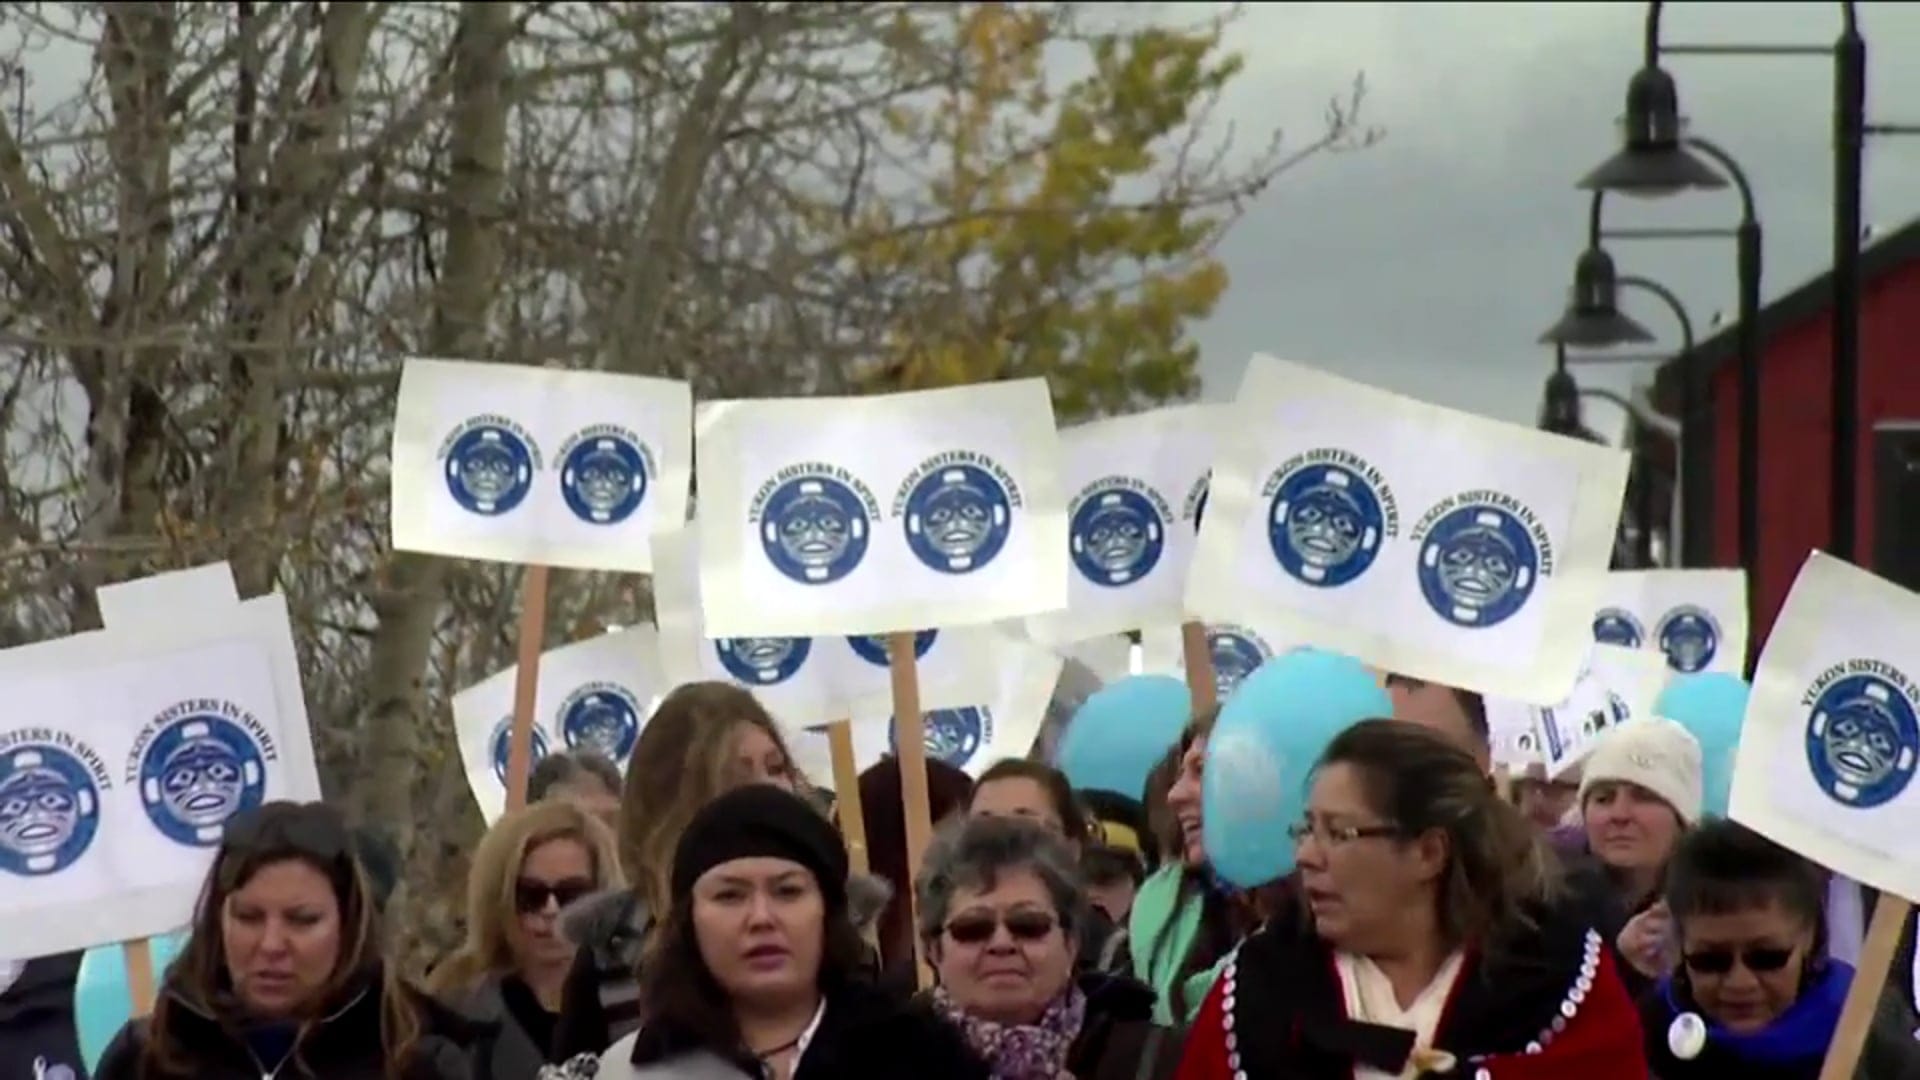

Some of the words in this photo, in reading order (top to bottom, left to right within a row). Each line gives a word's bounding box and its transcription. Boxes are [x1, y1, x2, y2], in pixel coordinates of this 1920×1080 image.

[748, 471, 778, 523] YUKON
[779, 463, 833, 482] SISTERS
[835, 465, 852, 482] IN
[851, 474, 882, 523] SPIRIT
[892, 467, 921, 517] YUKON
[919, 450, 976, 474] SISTERS
[977, 452, 994, 468] IN
[994, 461, 1023, 510] SPIRIT
[1262, 454, 1305, 497] YUKON
[1306, 448, 1367, 472] SISTERS
[1367, 465, 1384, 486] IN
[1379, 482, 1399, 538] SPIRIT
[1410, 496, 1456, 541] YUKON
[1457, 489, 1521, 511] SISTERS
[1520, 504, 1537, 525] IN
[1532, 521, 1553, 578] SPIRIT
[1801, 662, 1847, 708] YUKON
[1848, 658, 1907, 687] SISTERS
[0, 727, 53, 745] STERS
[55, 730, 74, 747] IN
[74, 741, 113, 791] SPIRIT
[125, 727, 155, 784] YUKON
[154, 698, 221, 729] SISTERS
[222, 701, 241, 718] IN
[242, 711, 279, 763] SPIRIT
